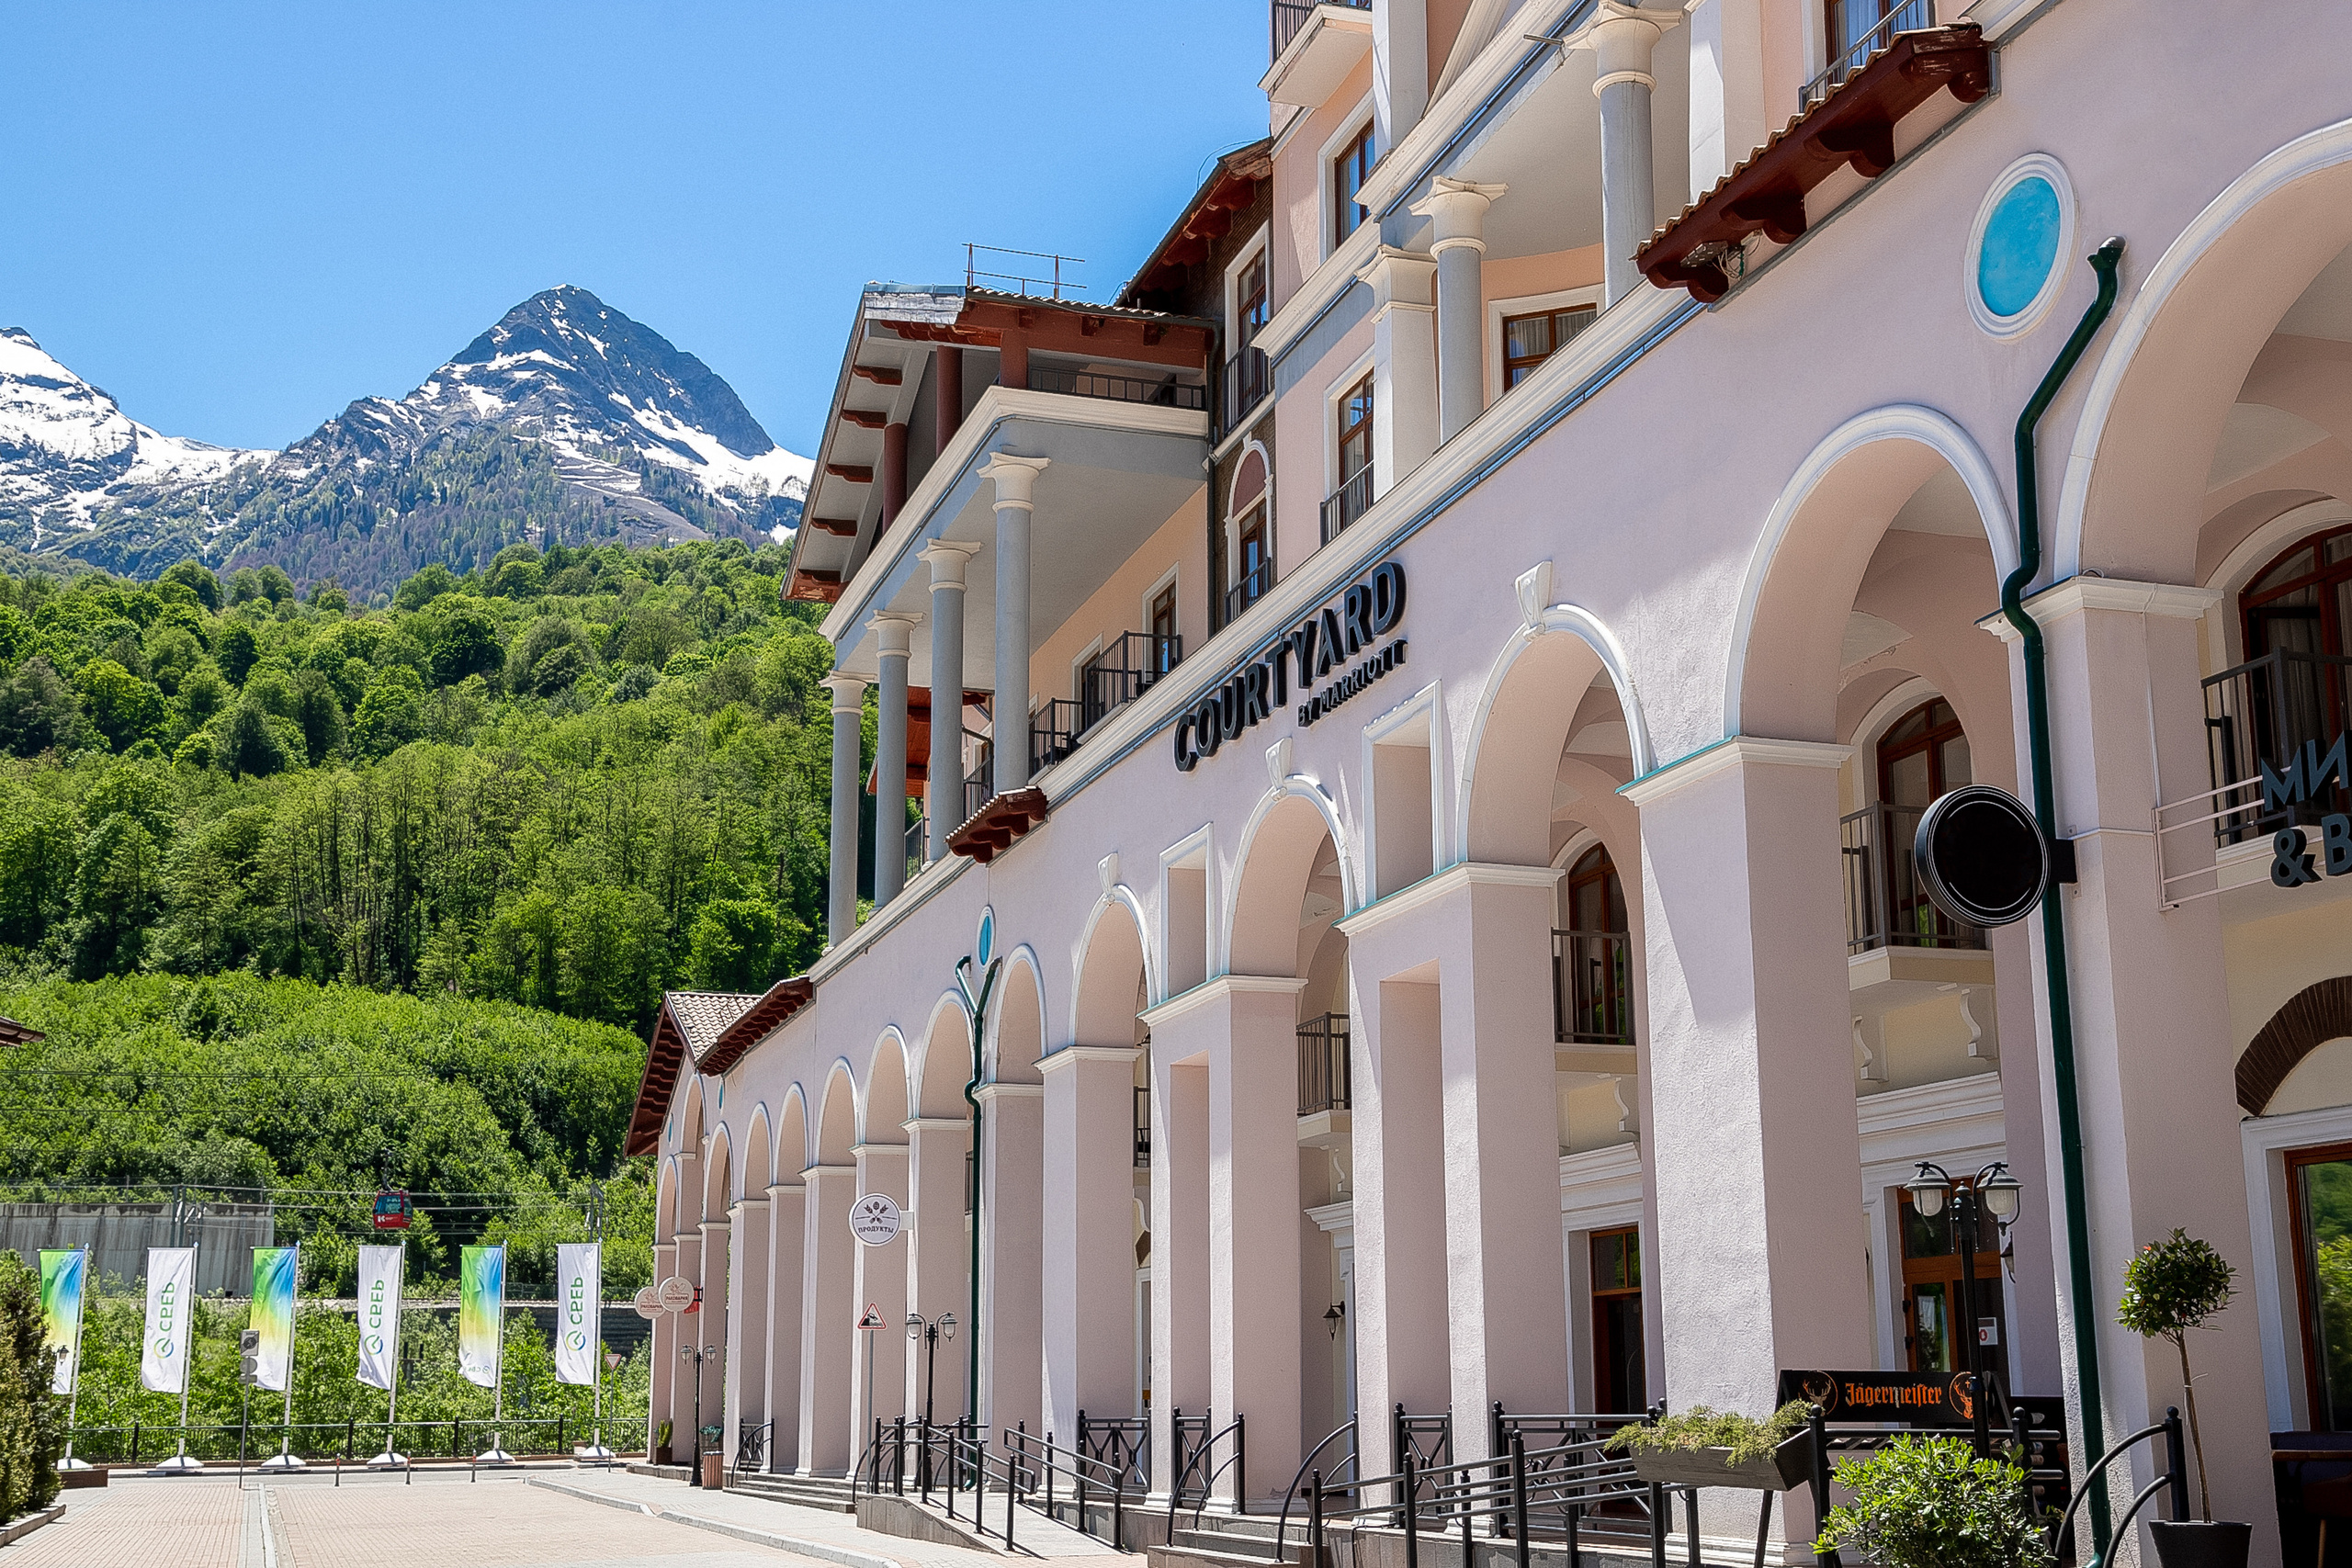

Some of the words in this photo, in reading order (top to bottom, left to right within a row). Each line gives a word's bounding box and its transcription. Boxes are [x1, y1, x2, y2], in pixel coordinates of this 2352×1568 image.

[1173, 561, 1408, 773] COURTYARD
[1297, 697, 1321, 728] BY
[1319, 639, 1408, 713] MARRIOTT
[2270, 828, 2323, 888] &
[857, 1225, 894, 1234] ПРОДУКТЫ
[1845, 1382, 1942, 1408] Jägermeister
